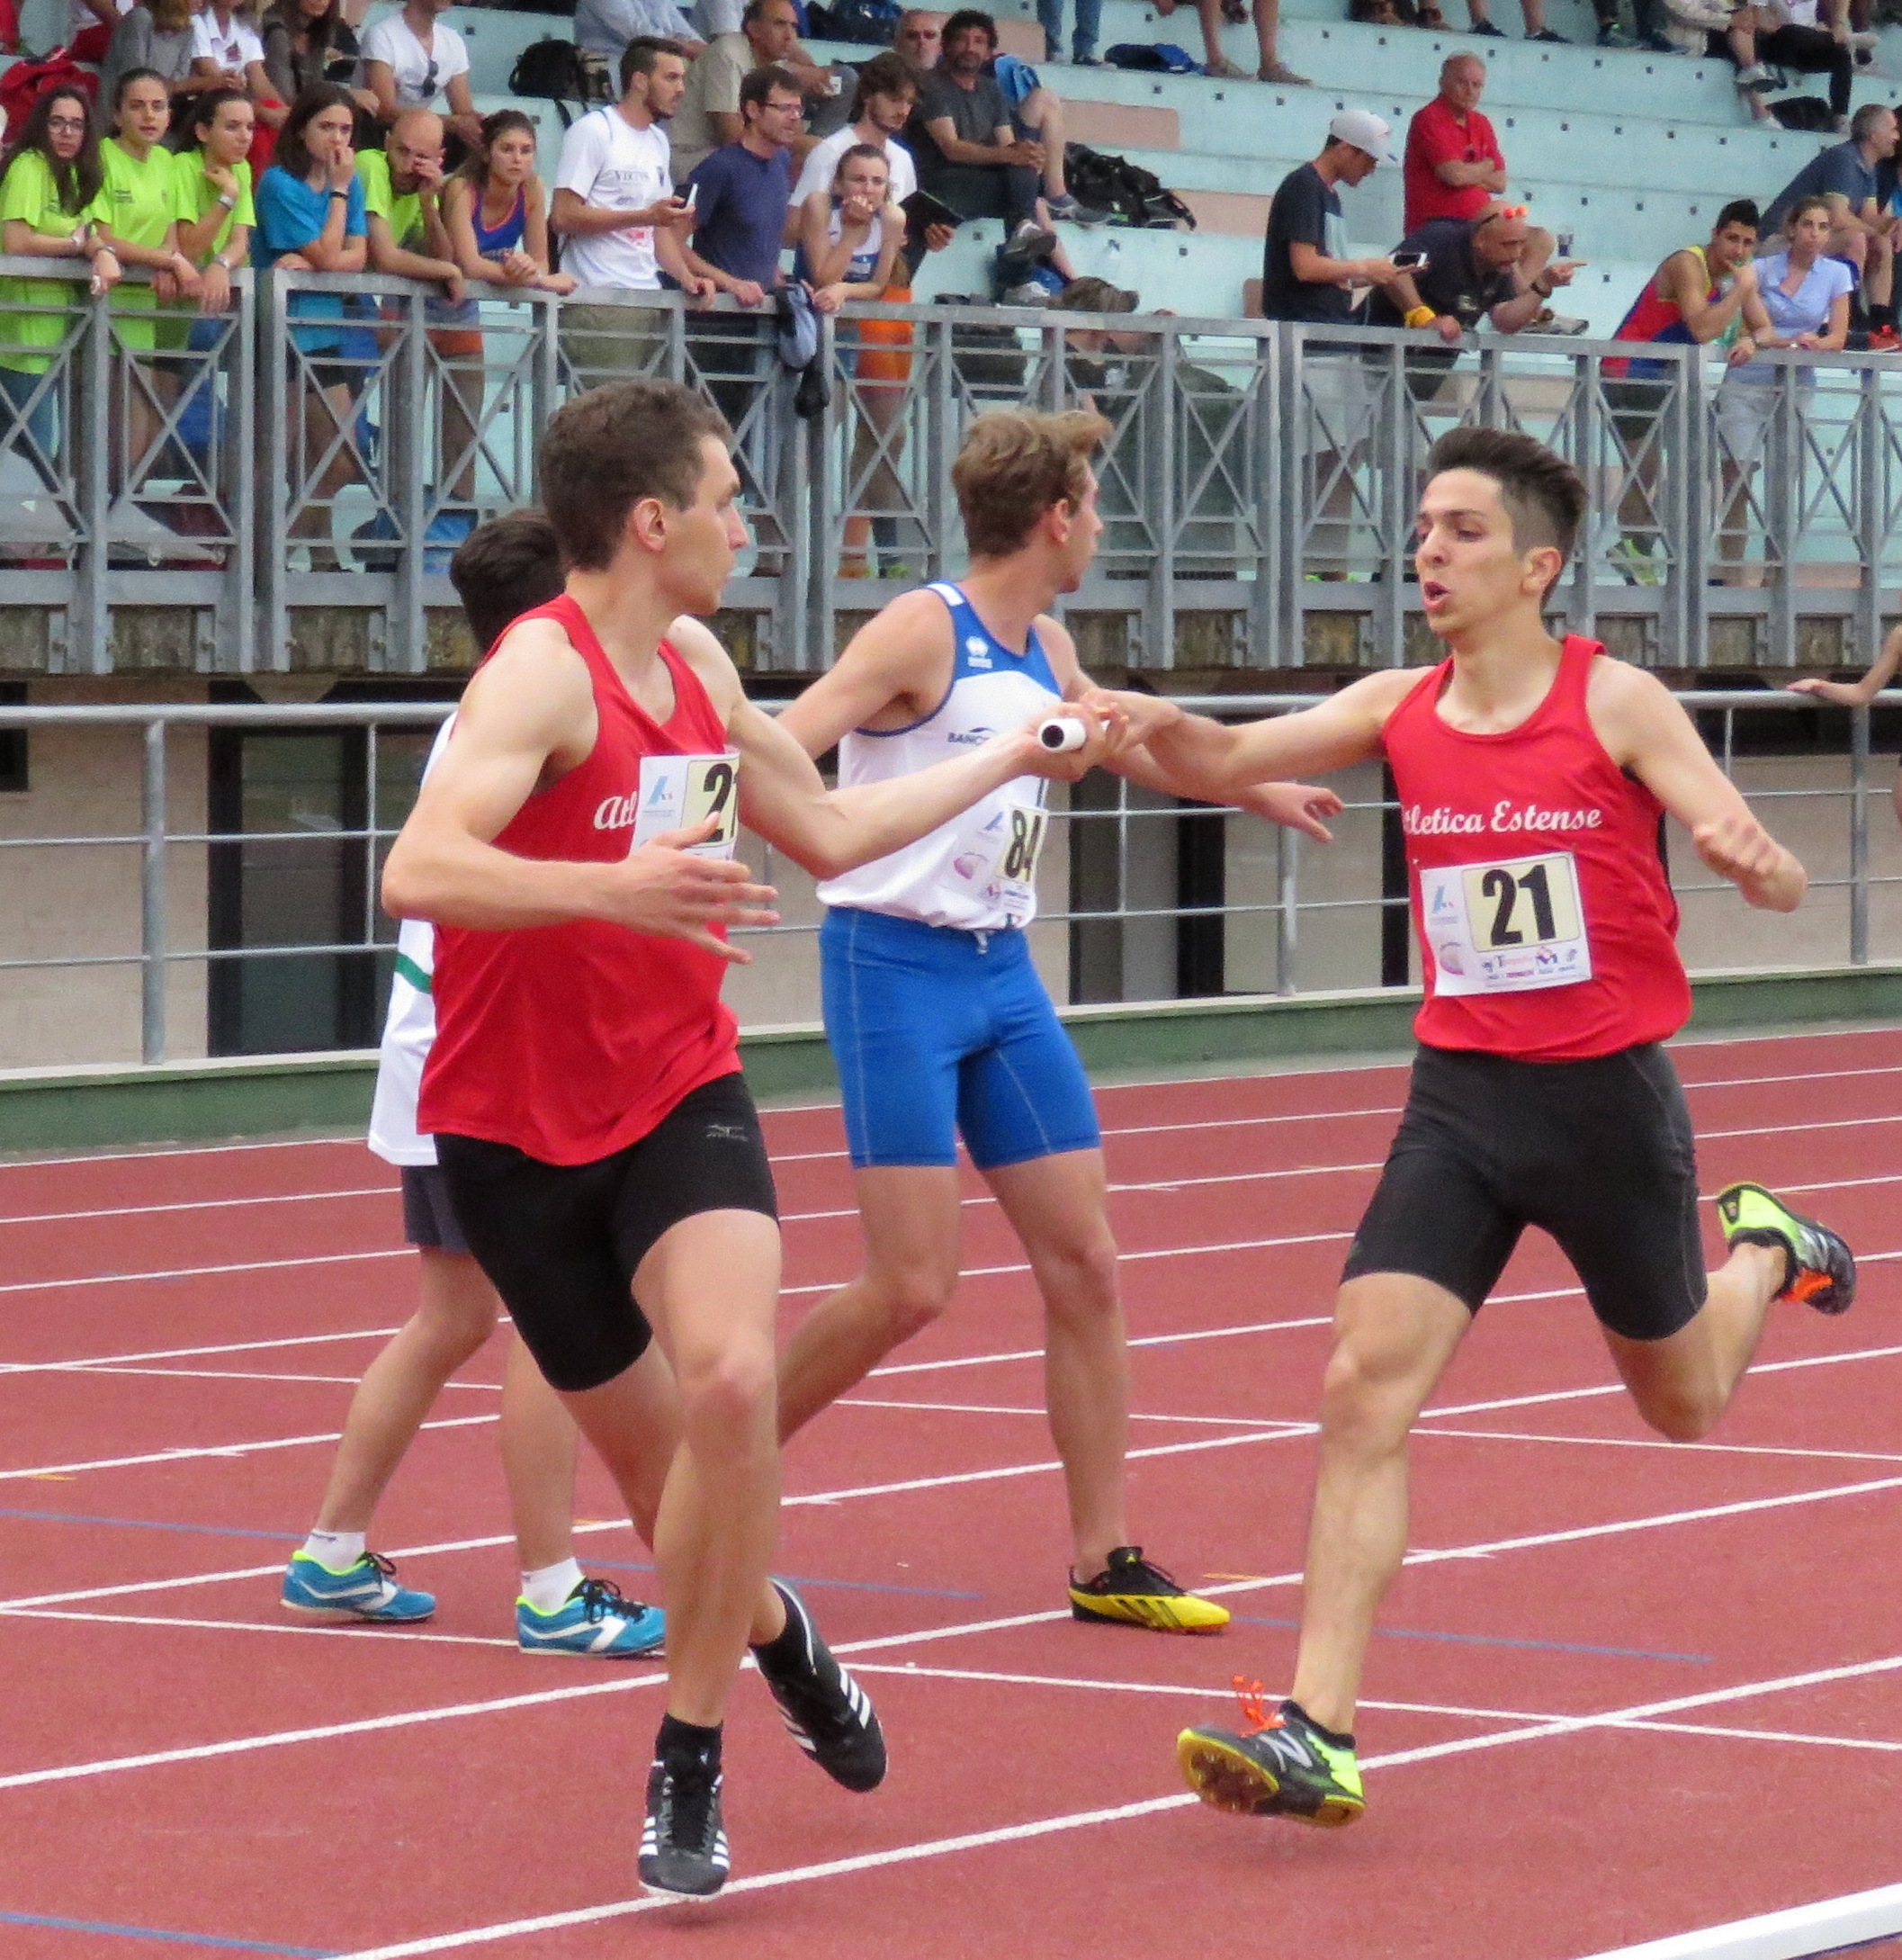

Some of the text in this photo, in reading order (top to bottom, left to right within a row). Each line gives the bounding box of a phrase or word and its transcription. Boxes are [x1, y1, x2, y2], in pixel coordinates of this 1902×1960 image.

[703, 762, 739, 843] 2
[1490, 800, 1602, 833] Estense
[1481, 864, 1557, 947] 21
